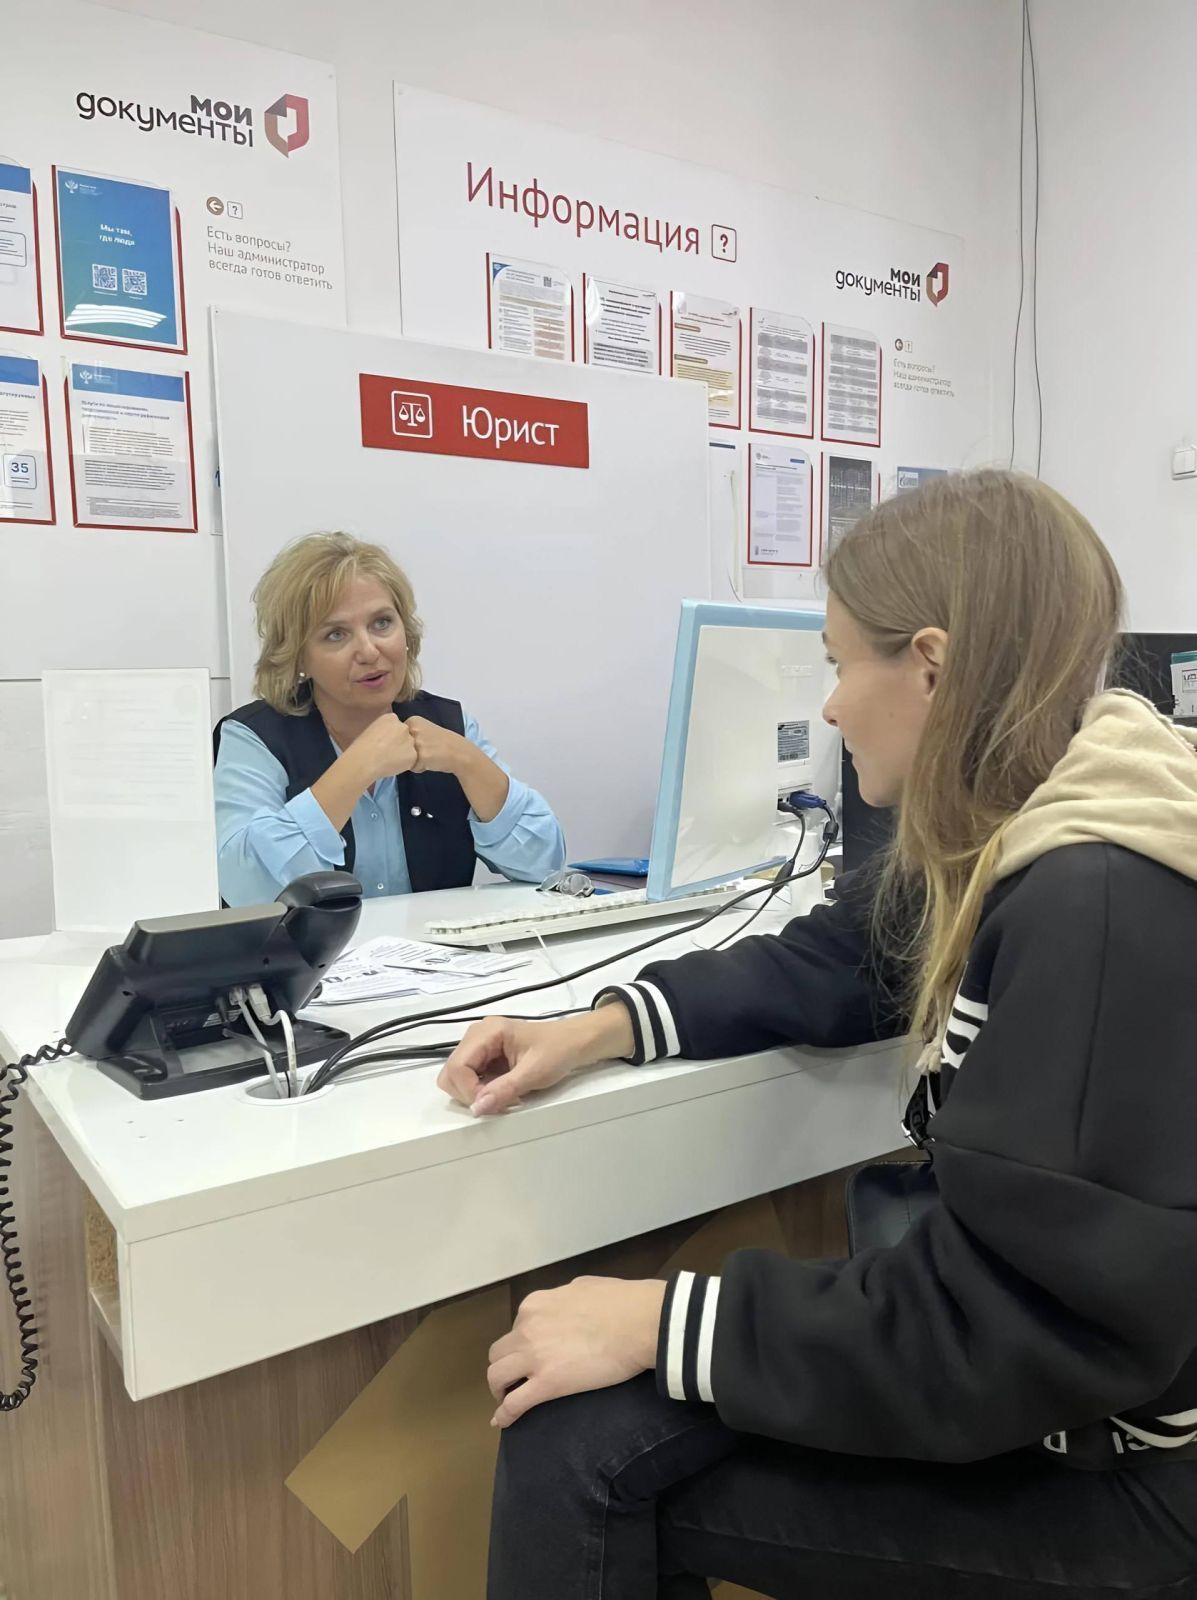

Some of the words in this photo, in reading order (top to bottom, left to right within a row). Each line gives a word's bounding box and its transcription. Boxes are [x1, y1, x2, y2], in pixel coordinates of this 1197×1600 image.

[76, 92, 253, 147] документы
[190, 94, 253, 127] мои
[467, 162, 700, 255] Информация
[207, 225, 232, 241] Есть
[235, 234, 291, 253] вопросы?
[208, 241, 234, 257] Наш
[238, 249, 325, 276] администратор
[209, 259, 247, 275] всегда
[251, 266, 281, 281] готов
[285, 273, 333, 290] ответить
[835, 269, 920, 302] документы
[890, 267, 920, 287] мои
[462, 404, 560, 449] Юрист
[11, 462, 29, 474] 35
